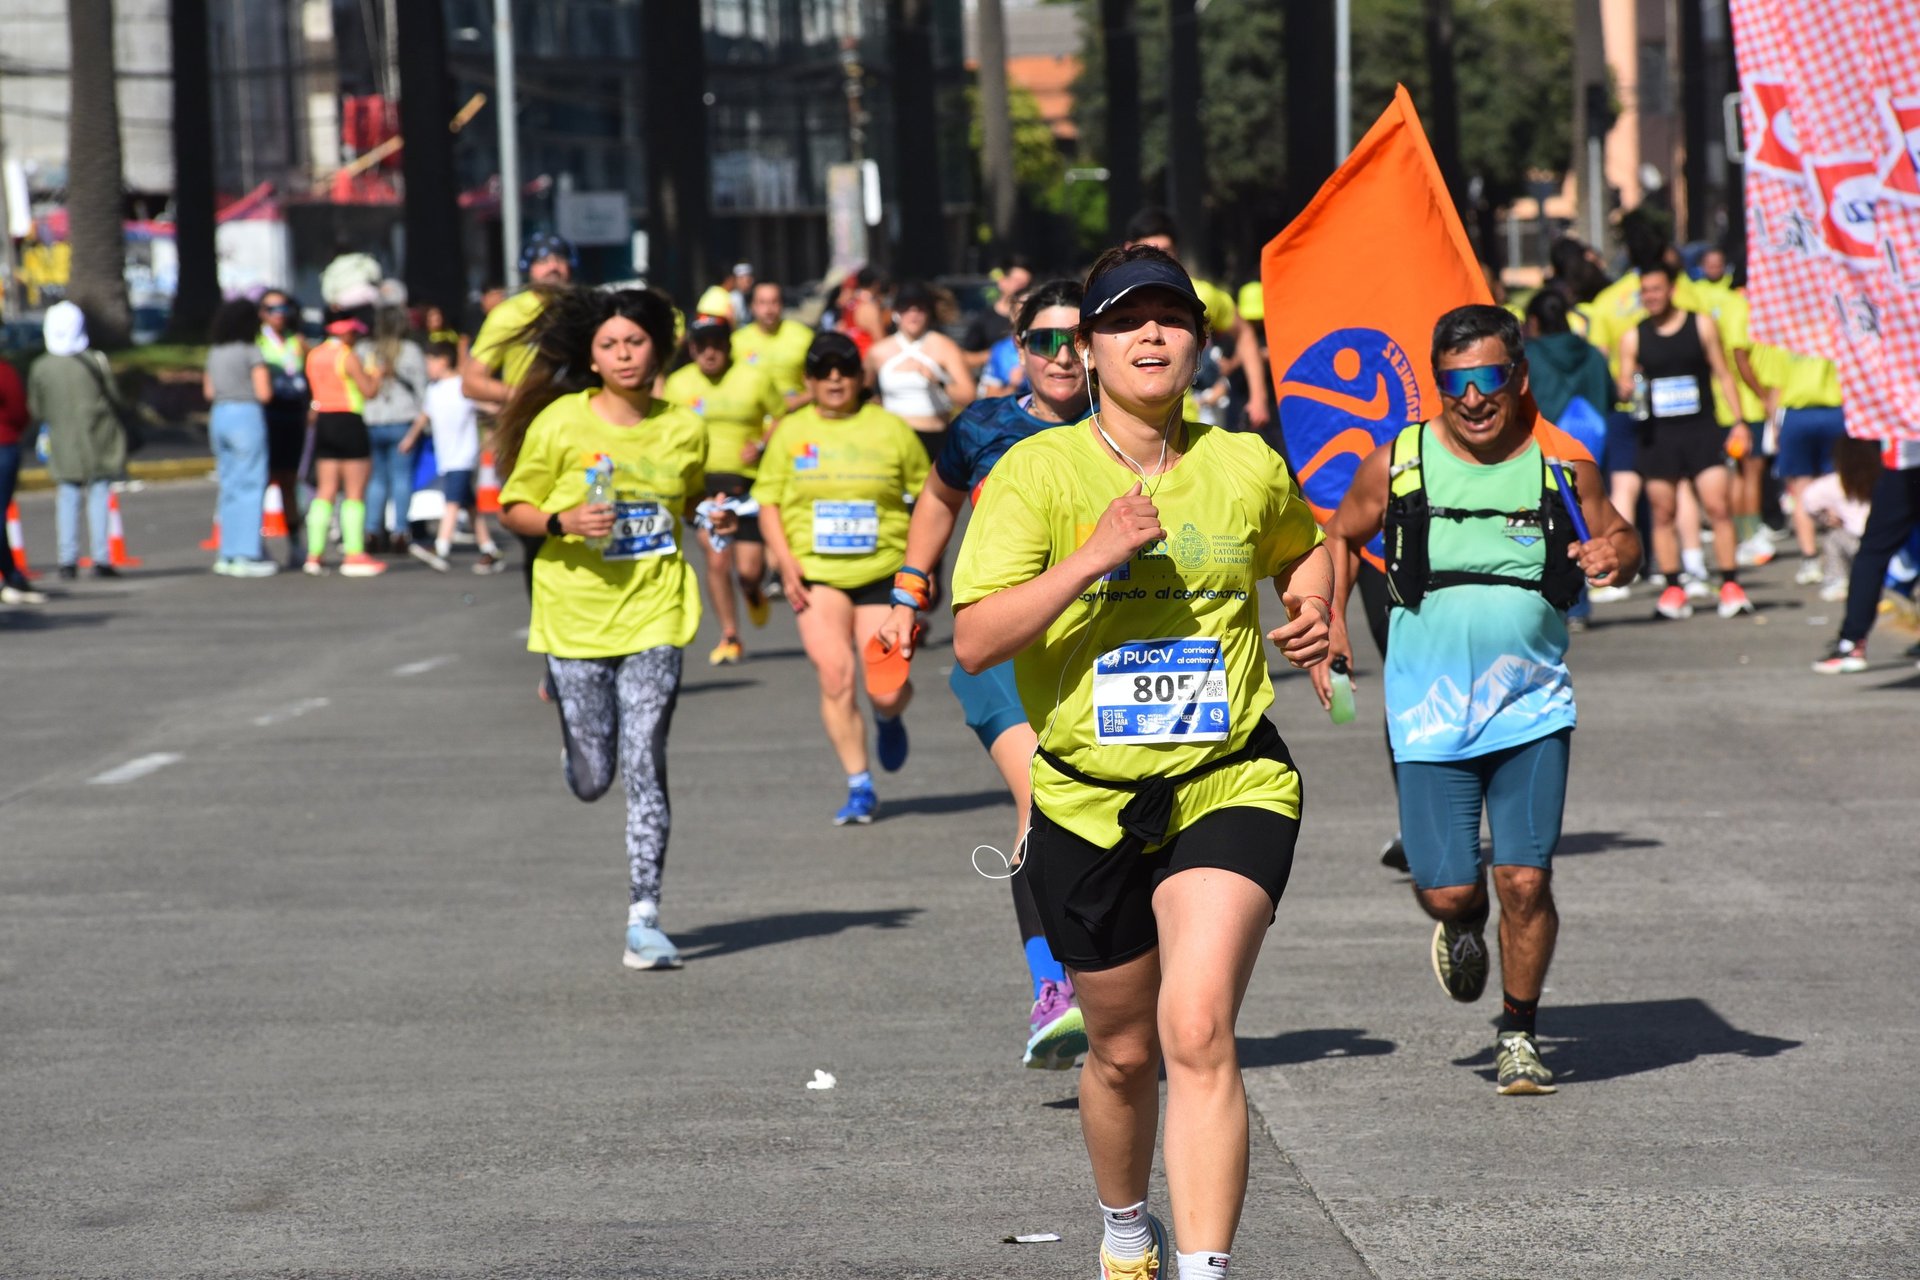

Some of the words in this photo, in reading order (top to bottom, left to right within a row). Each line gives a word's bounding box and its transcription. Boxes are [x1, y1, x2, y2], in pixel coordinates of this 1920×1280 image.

[1382, 341, 1420, 422] RUNNERS
[621, 517, 655, 536] 670
[1155, 586, 1170, 599] al
[1173, 587, 1248, 601] centenario
[1123, 648, 1174, 665] PUCV
[1176, 656, 1185, 664] al
[1133, 675, 1196, 703] 805
